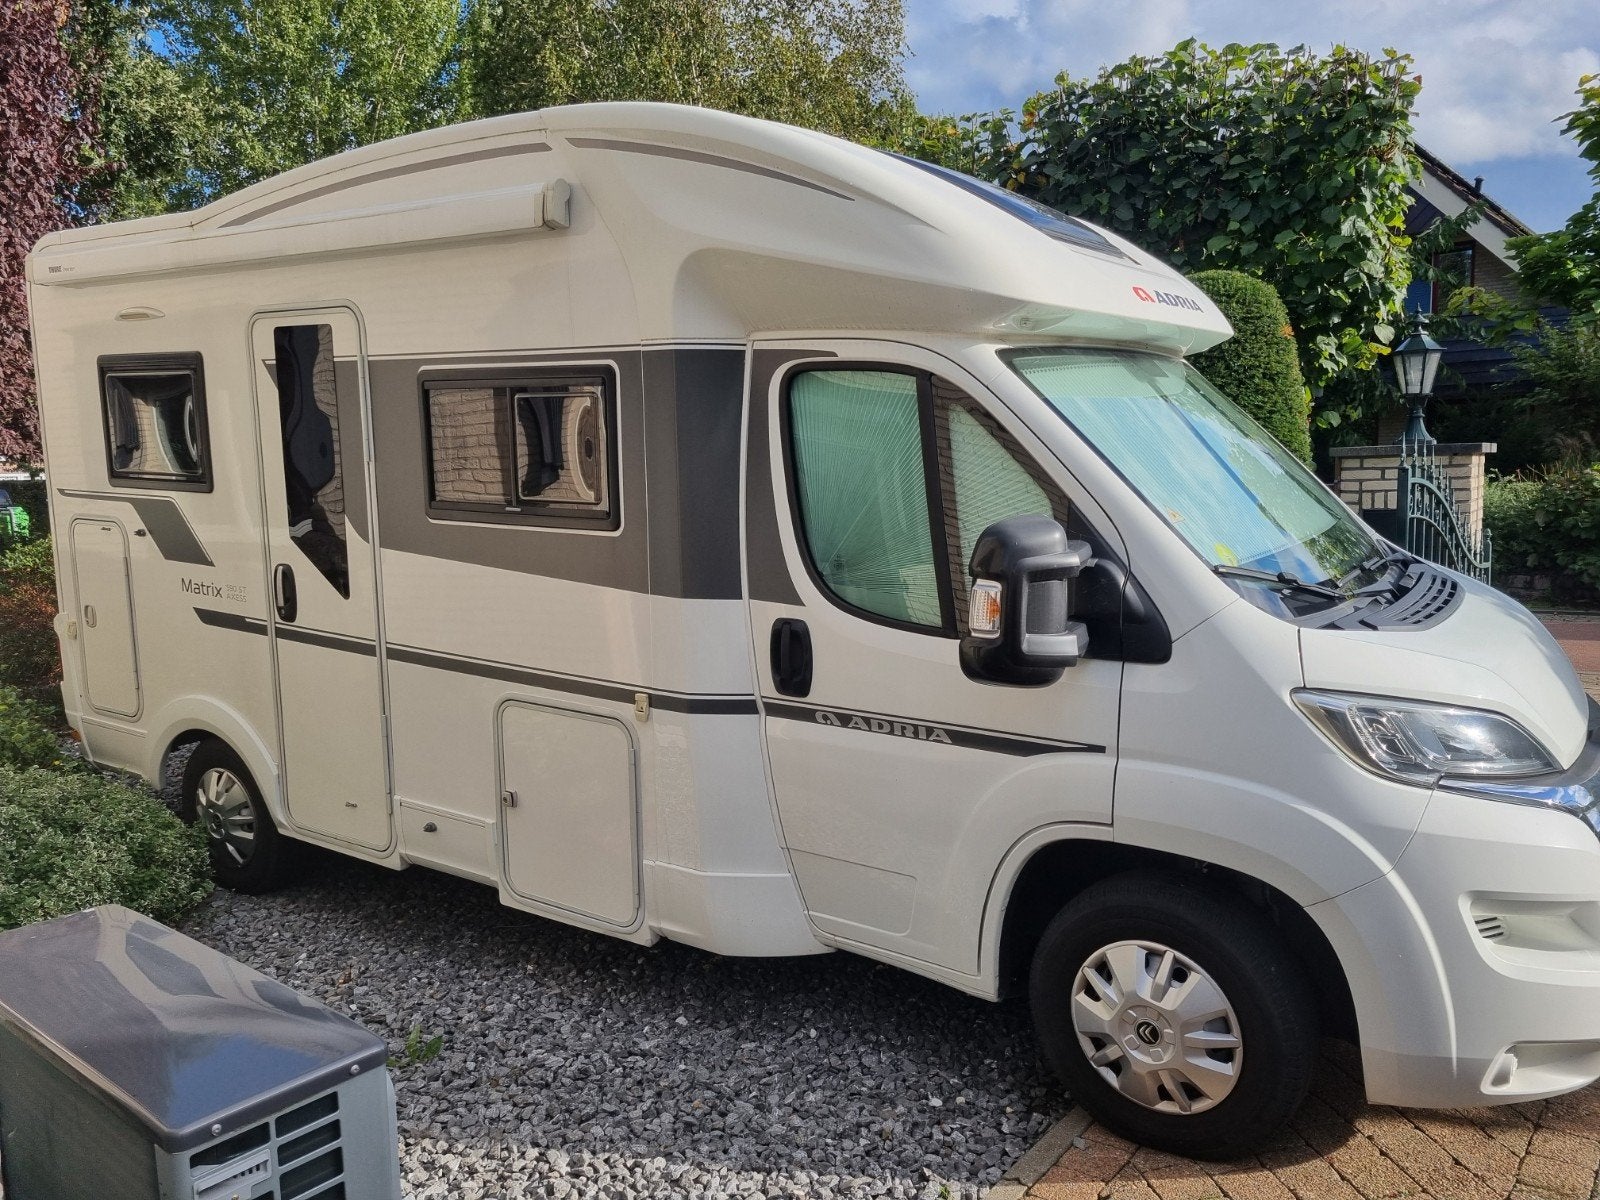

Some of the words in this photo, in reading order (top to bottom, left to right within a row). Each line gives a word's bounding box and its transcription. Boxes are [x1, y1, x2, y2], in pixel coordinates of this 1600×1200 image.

[1153, 285, 1204, 313] ADRIA
[181, 577, 223, 598] Matrix
[847, 715, 953, 744] ADRIA
